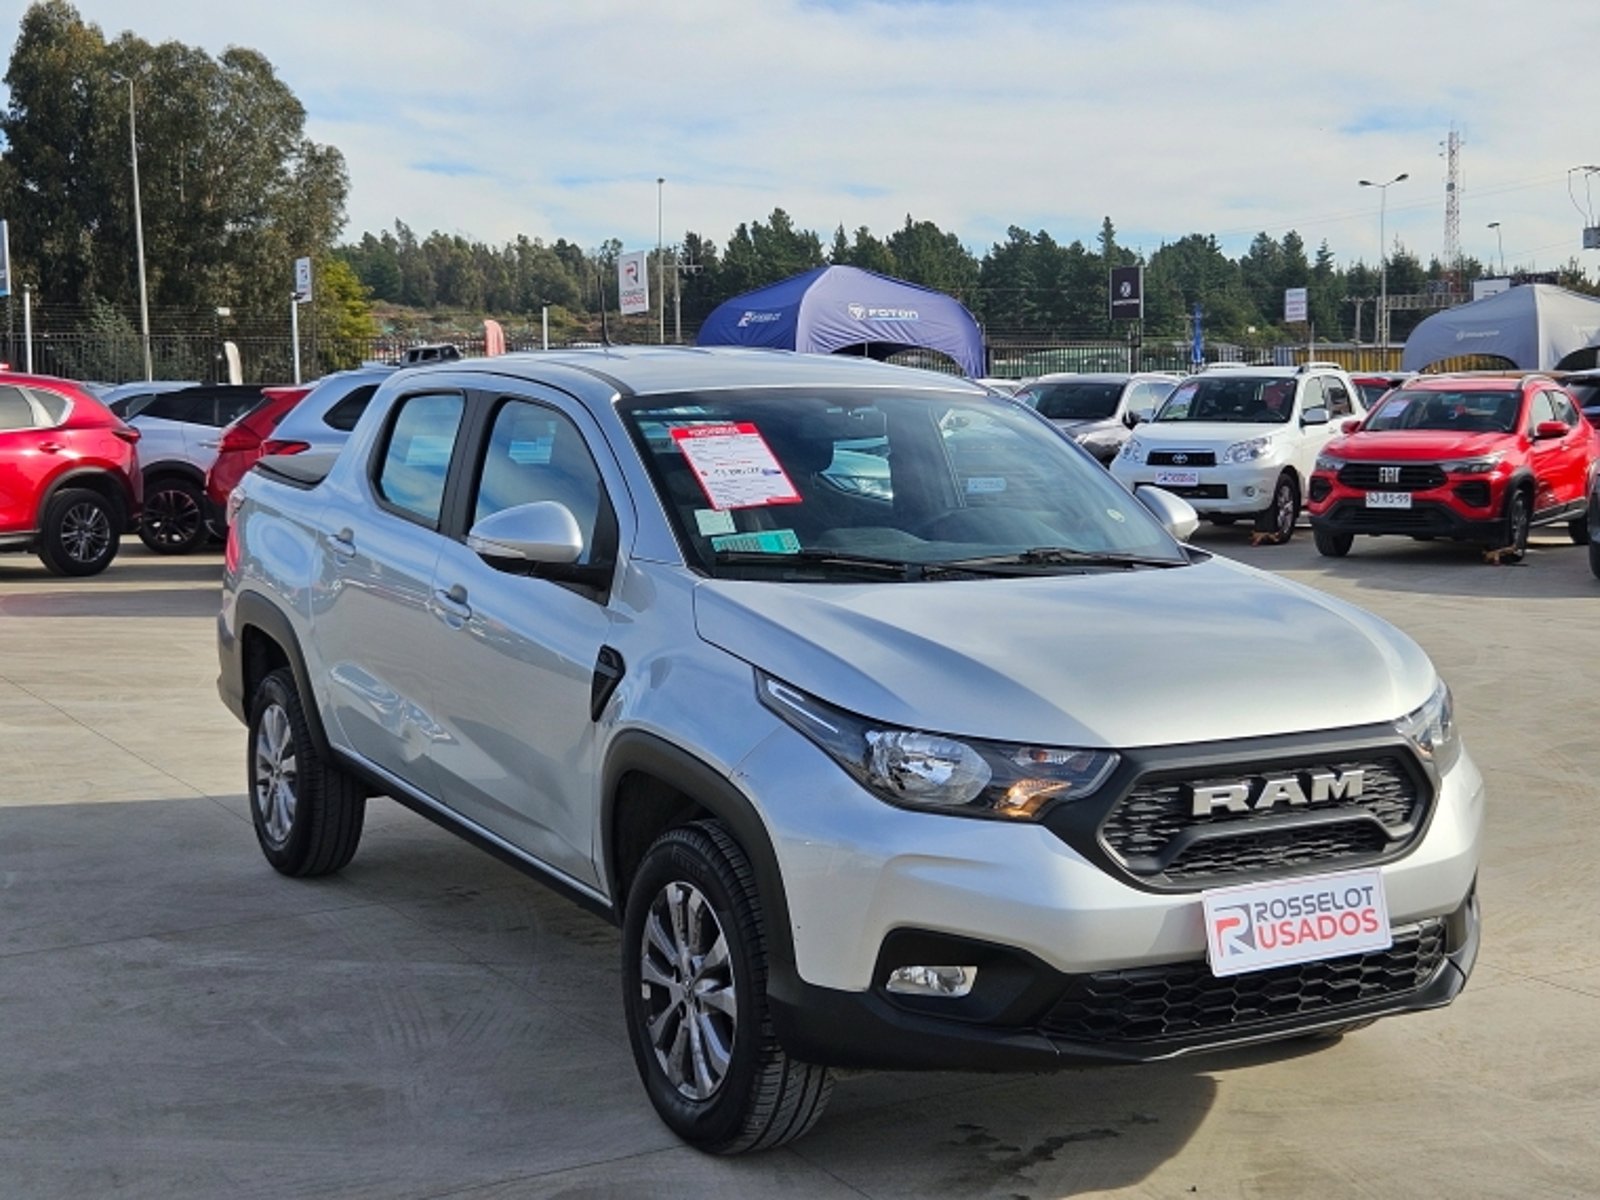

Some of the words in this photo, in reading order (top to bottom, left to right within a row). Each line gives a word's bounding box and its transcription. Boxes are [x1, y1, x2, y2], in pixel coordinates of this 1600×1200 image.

[1192, 769, 1365, 816] RAM
[1254, 885, 1374, 923] ROSSELOT
[1257, 908, 1380, 949] USADOS
